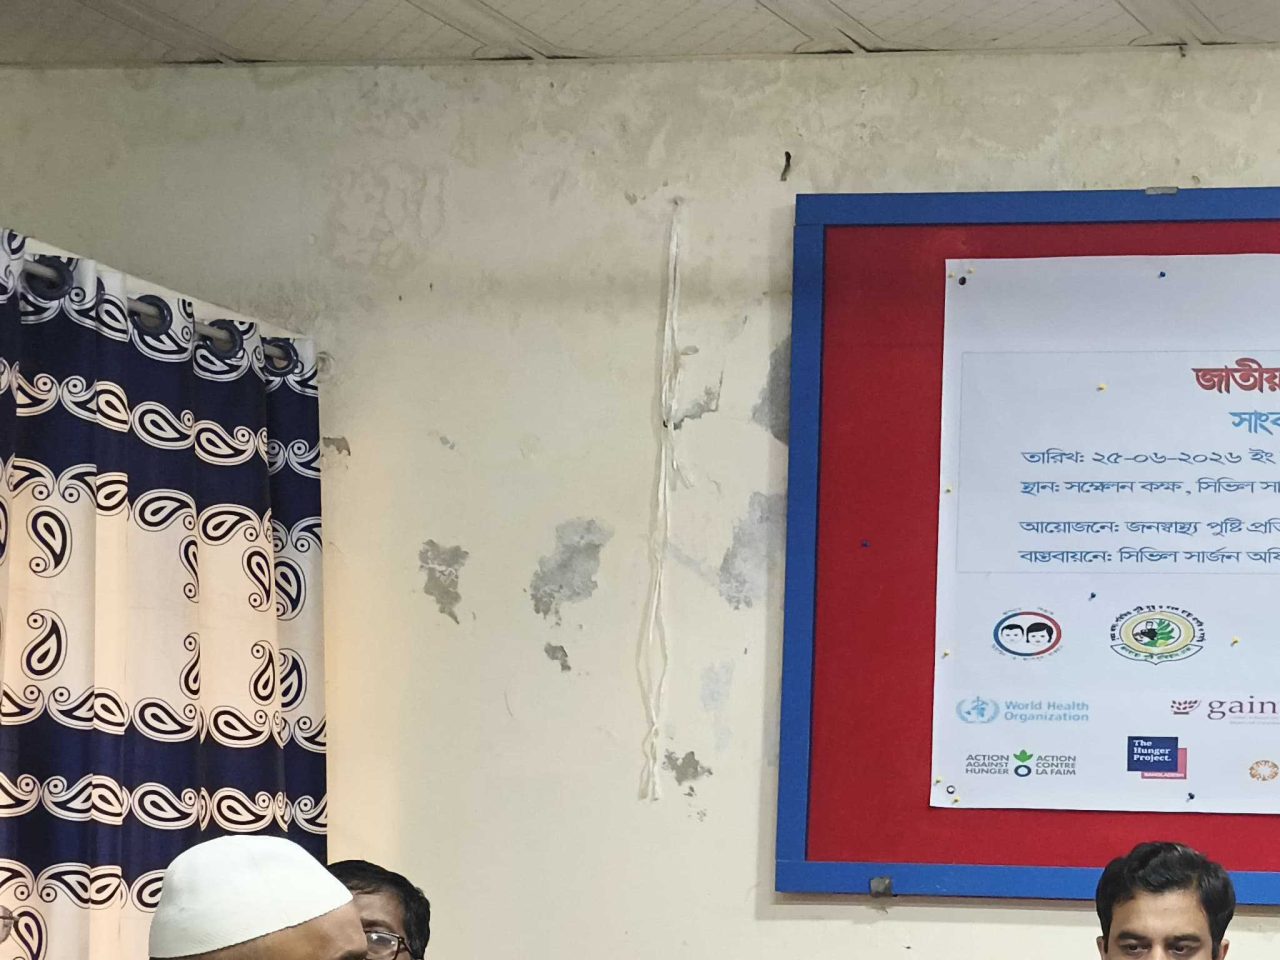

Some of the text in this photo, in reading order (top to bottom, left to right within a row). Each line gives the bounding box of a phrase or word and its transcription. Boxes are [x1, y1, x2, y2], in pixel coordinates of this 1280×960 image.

[1249, 448, 1276, 464] ইং
[1064, 481, 1136, 493] সম্মেলন
[1197, 477, 1254, 493] সিভিল
[1125, 521, 1201, 537] জনস্বাস্থ্য
[1207, 517, 1243, 537] পুষ্টি
[1118, 546, 1179, 562] সিভিল
[1184, 547, 1240, 563] সার্জন
[1004, 701, 1090, 711] World Health
[1207, 696, 1279, 720] gain
[1004, 712, 1090, 723] Organization
[1133, 739, 1152, 747] The
[1133, 747, 1172, 755] Hunger
[966, 754, 1009, 762] ACTION
[1133, 754, 1172, 762] Project.
